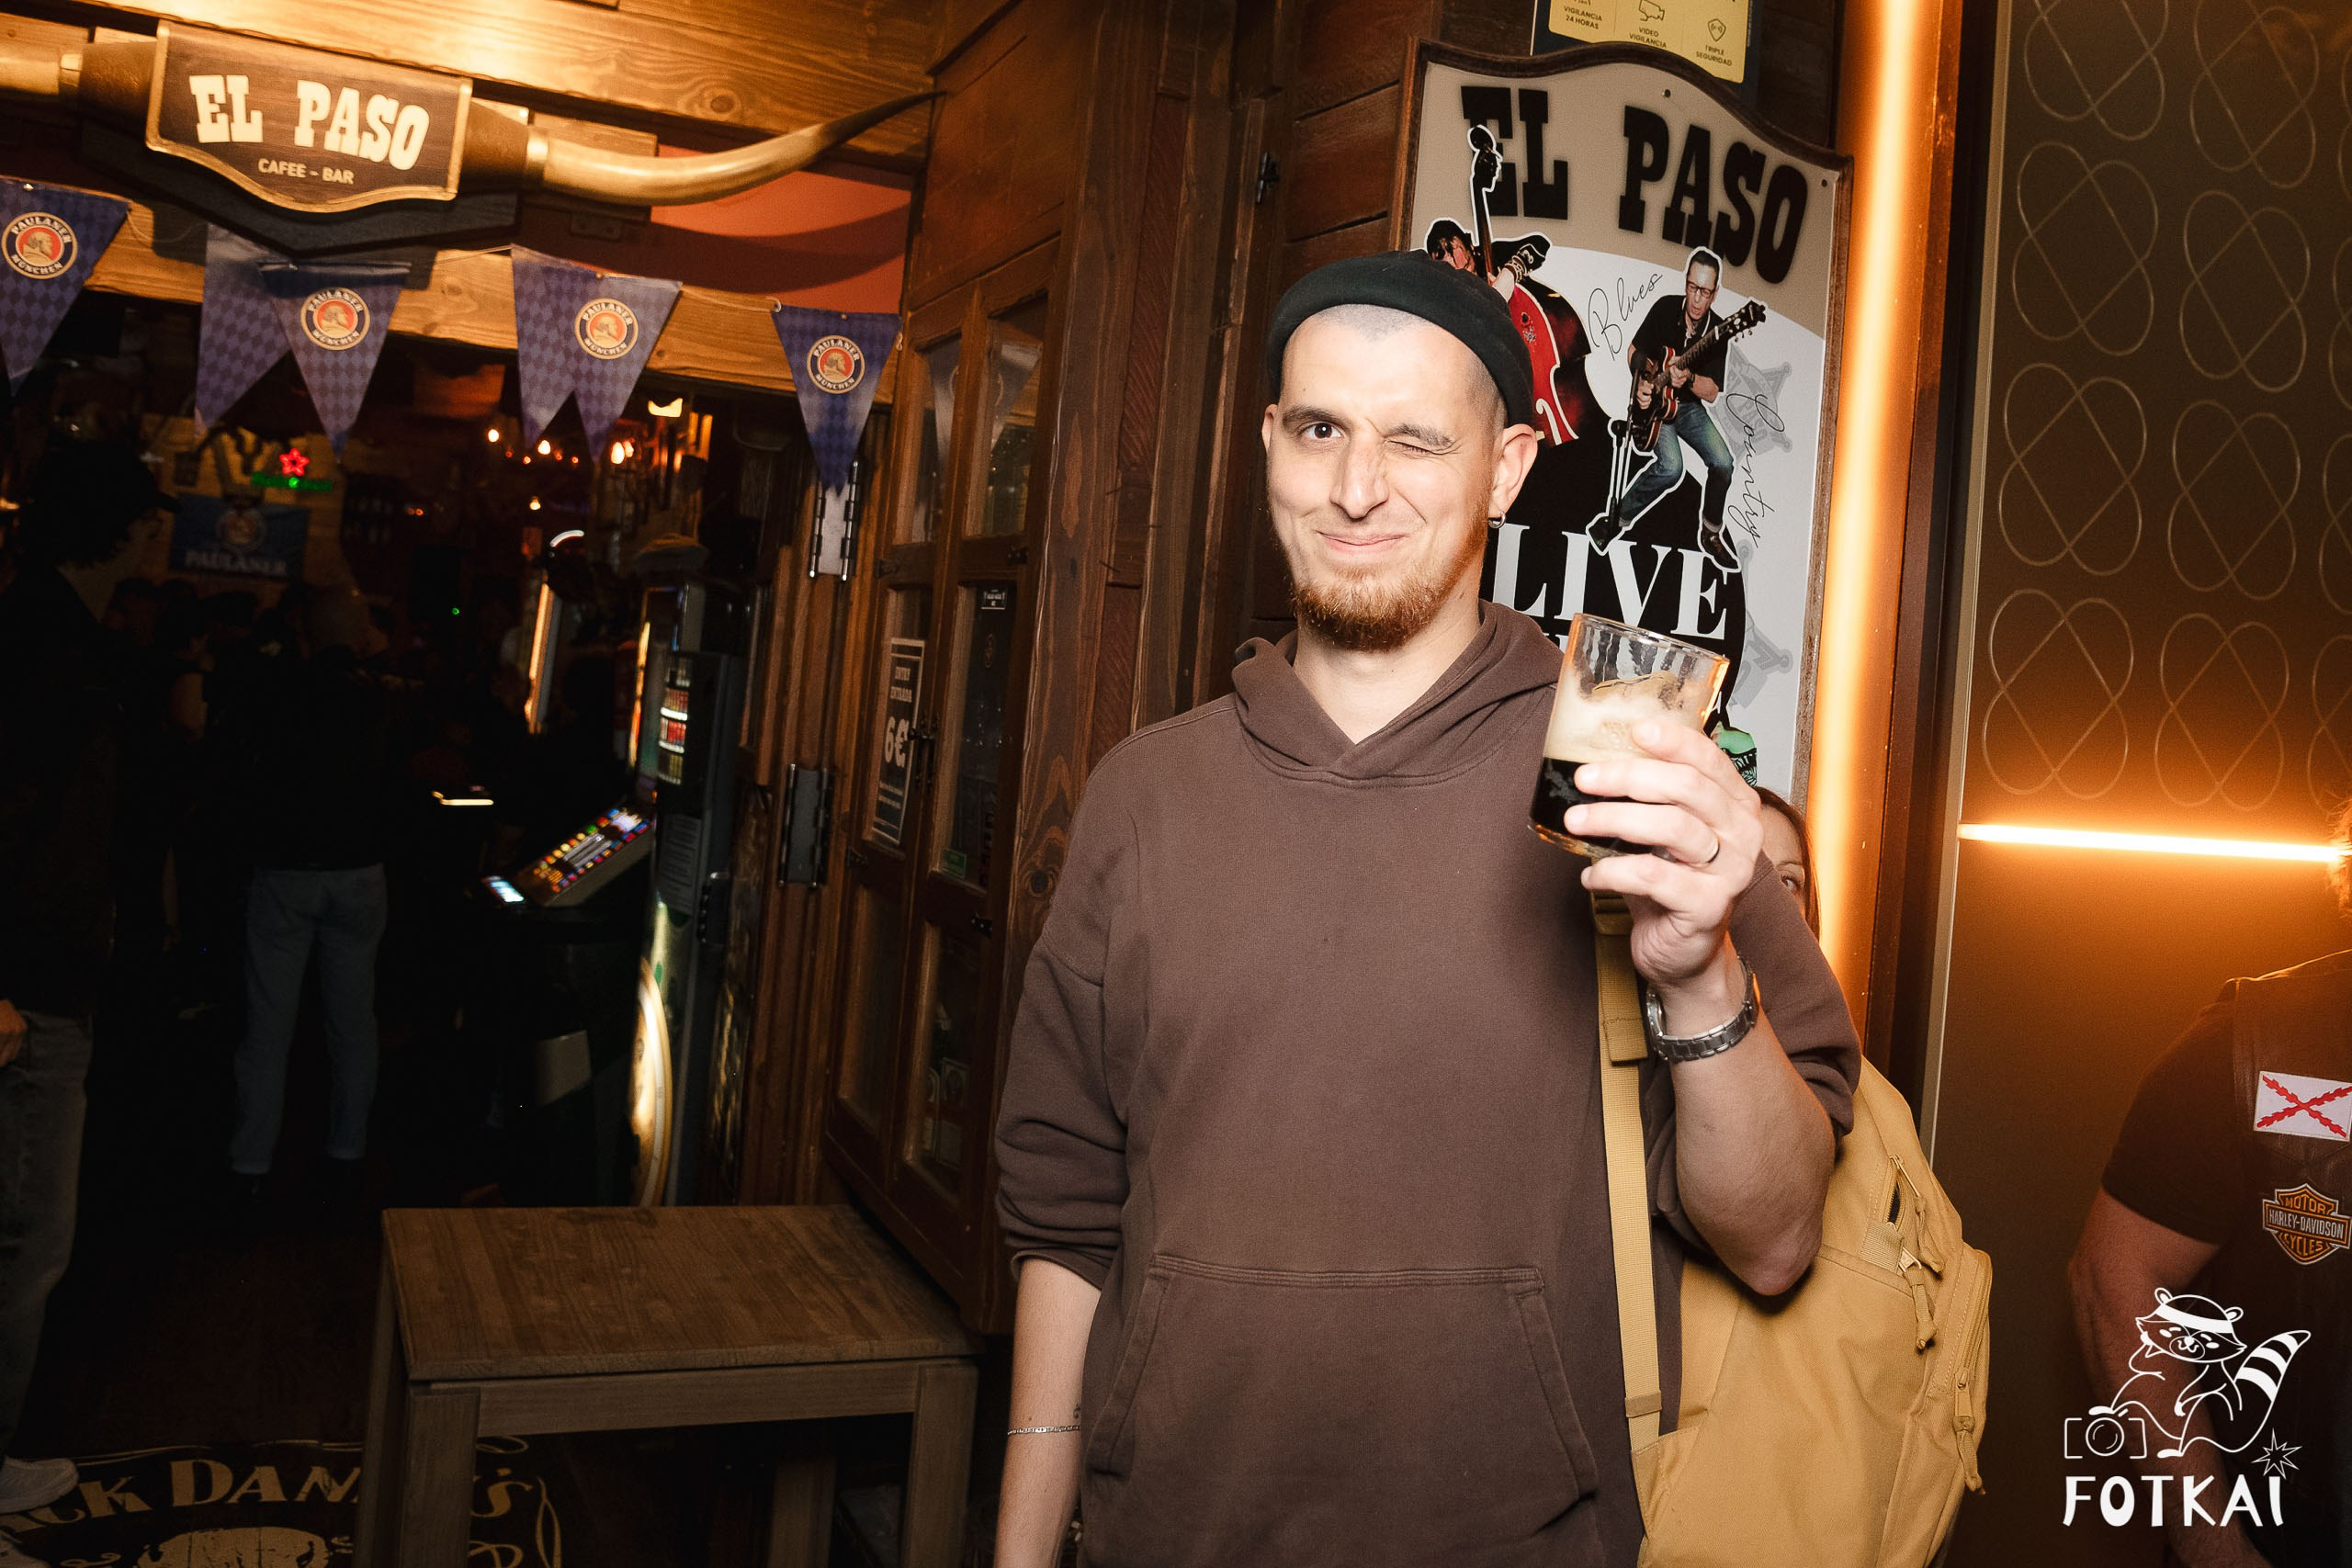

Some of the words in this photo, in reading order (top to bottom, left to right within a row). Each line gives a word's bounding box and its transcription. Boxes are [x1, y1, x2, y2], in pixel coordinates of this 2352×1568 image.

[1564, 6, 1602, 21] VIGILANCIA
[1566, 15, 1575, 24] 24
[1576, 18, 1600, 29] HORAS
[1629, 33, 1668, 49] VIGILANCIA
[1638, 27, 1659, 38] VIDEO
[1696, 51, 1733, 66] SEGURIDAD
[1705, 44, 1725, 56] TRIPLE
[188, 74, 264, 143] EL
[294, 79, 430, 171] PASO
[257, 158, 306, 178] CAFEE
[322, 167, 355, 185] BAR
[1461, 85, 1568, 220] EL
[1618, 105, 1808, 284] PASO
[11, 216, 73, 243] PAULANER
[582, 302, 634, 325] PAULANER
[1588, 272, 1663, 361] Blues
[813, 339, 860, 361] PAULANER
[1725, 392, 1786, 548] Country
[1492, 521, 1727, 640] LIVE
[2285, 1193, 2326, 1215] MOTOR
[2268, 1208, 2345, 1240] HARLEY-DAVIDSON
[2284, 1233, 2324, 1257] CYCLES
